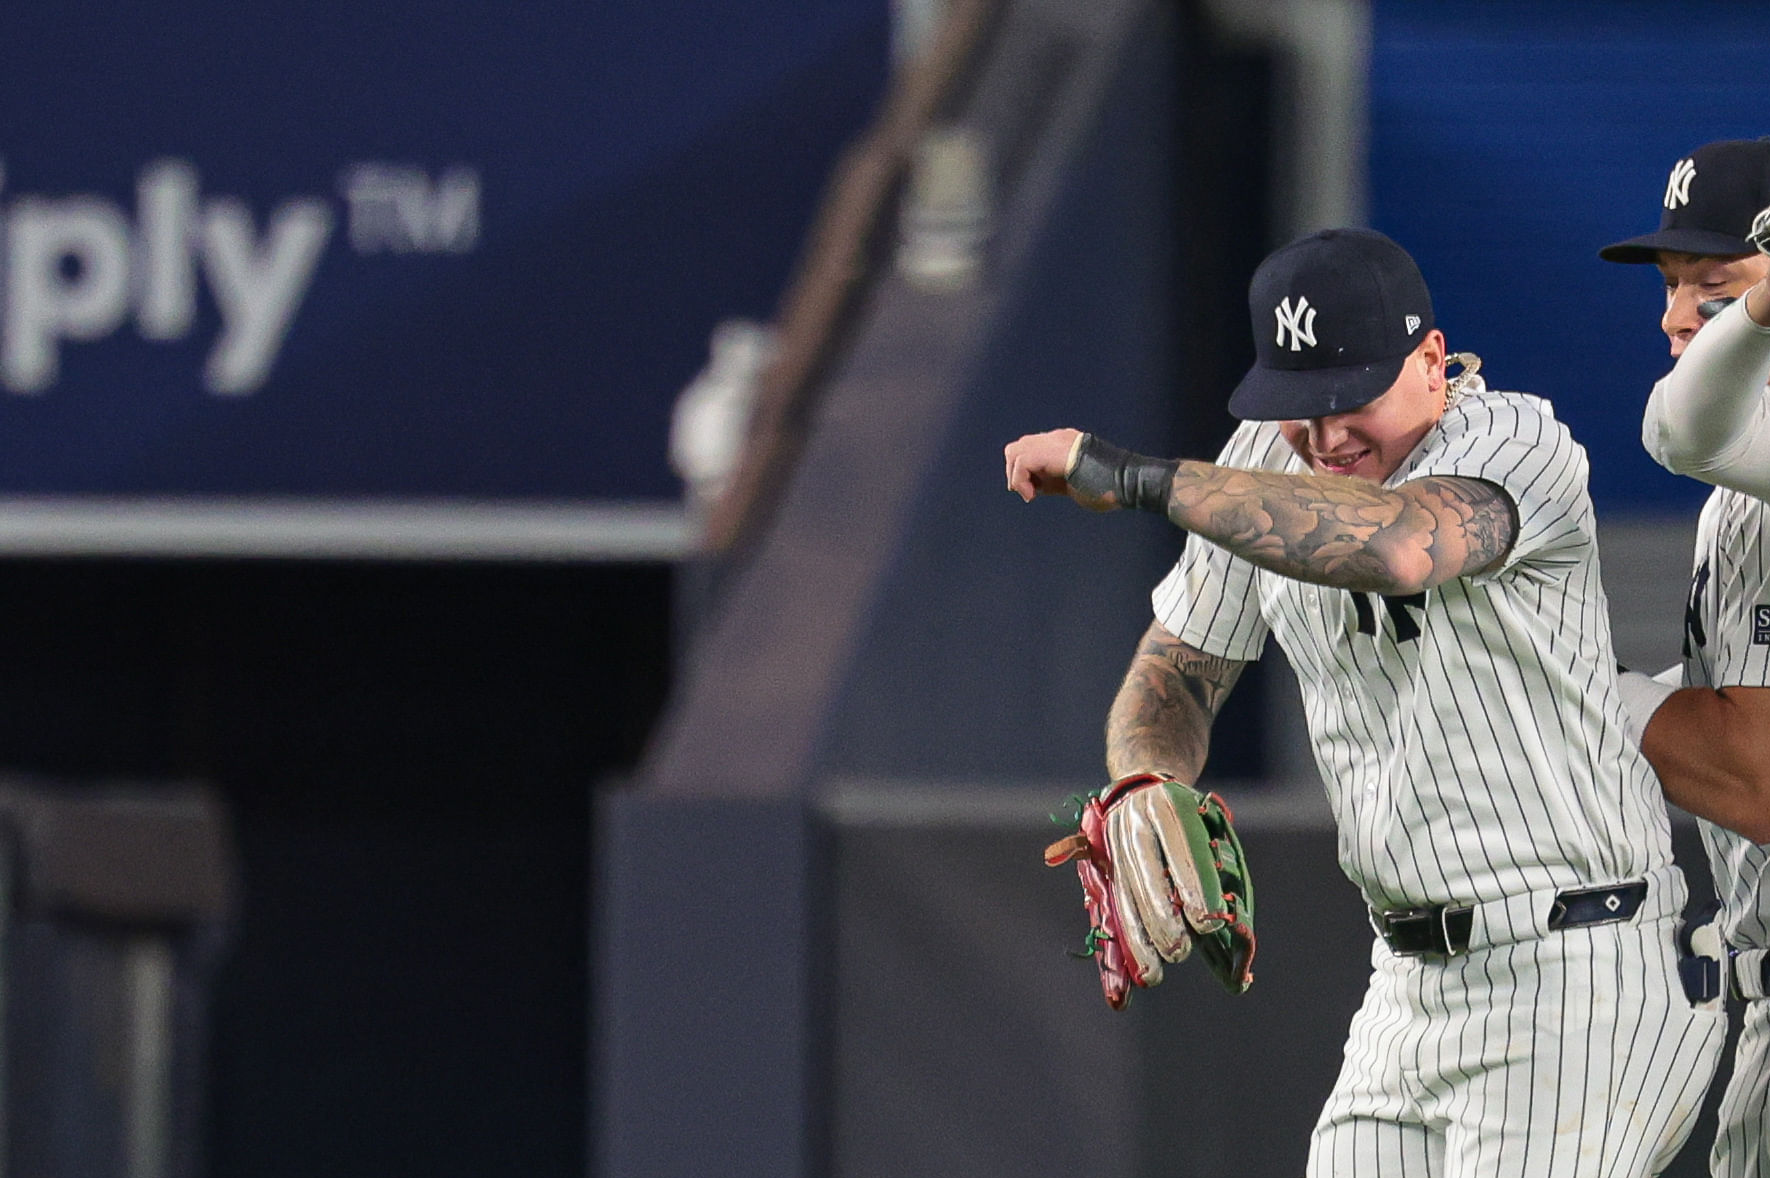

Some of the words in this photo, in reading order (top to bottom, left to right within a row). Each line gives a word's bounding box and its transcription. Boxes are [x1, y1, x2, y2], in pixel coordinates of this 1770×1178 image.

[1663, 158, 1697, 210] NY
[0, 155, 334, 395] ply
[1274, 295, 1318, 352] NY
